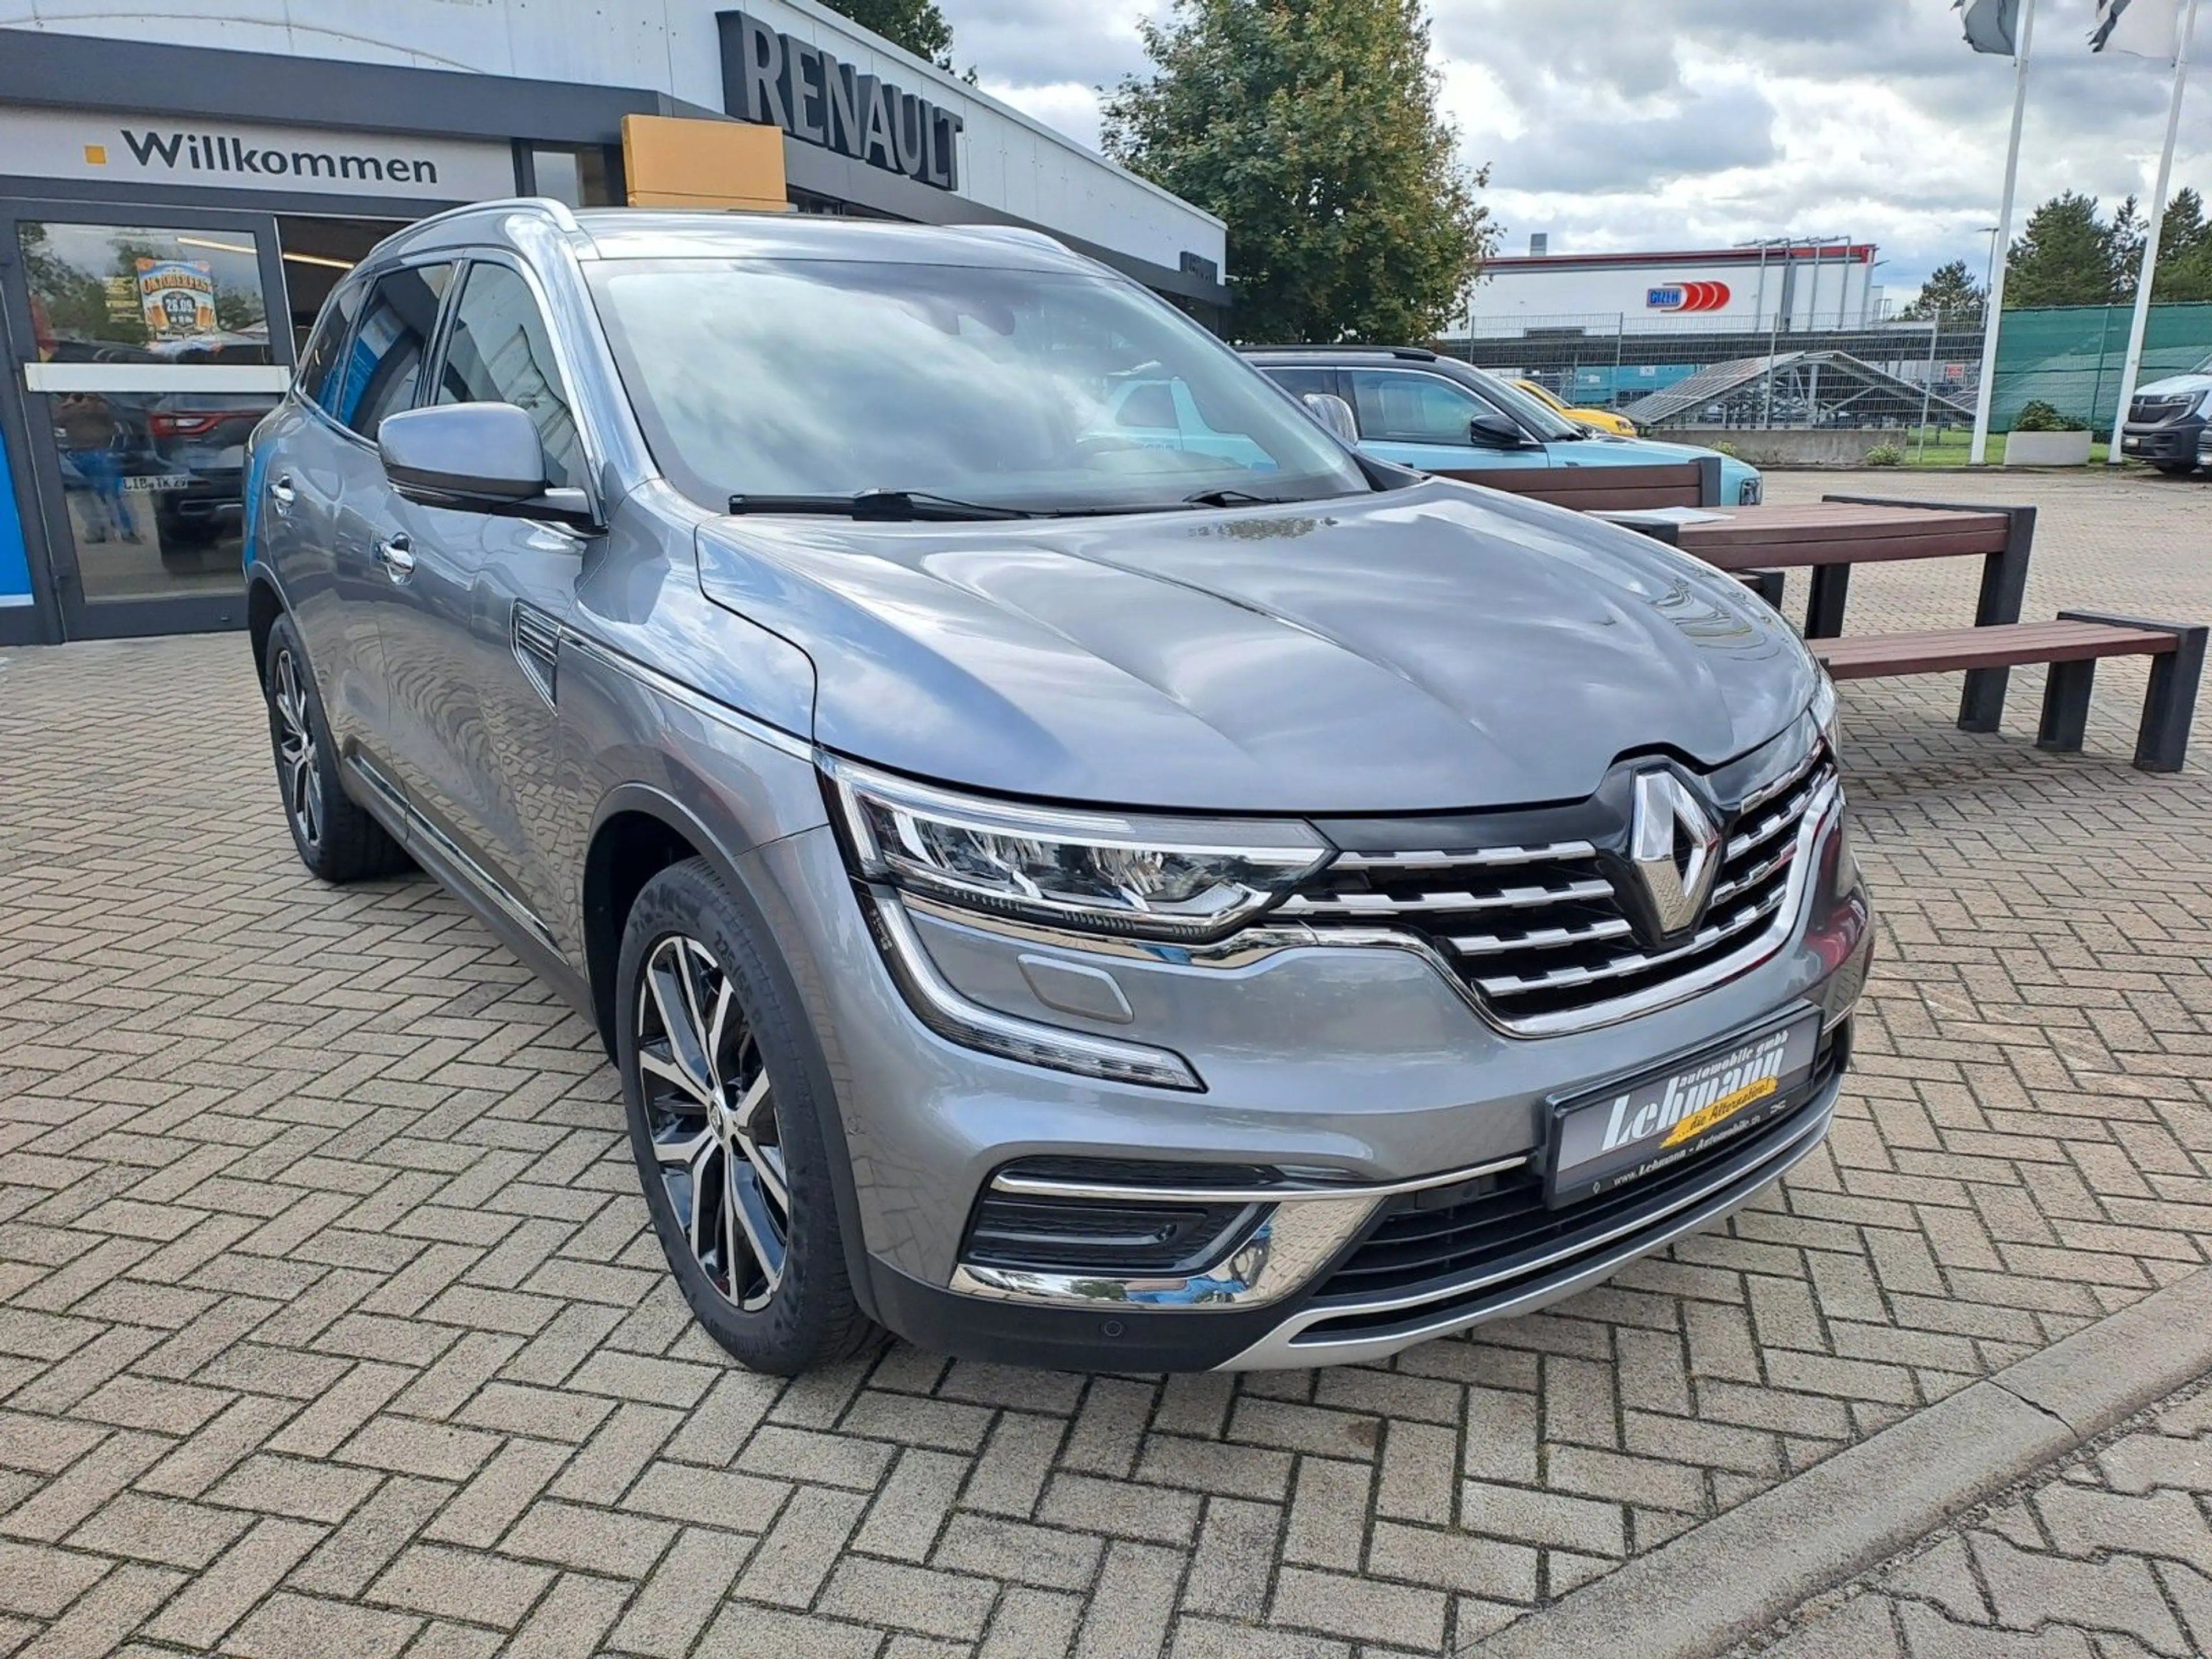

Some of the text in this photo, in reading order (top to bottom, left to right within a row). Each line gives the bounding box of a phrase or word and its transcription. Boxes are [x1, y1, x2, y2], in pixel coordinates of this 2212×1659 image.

[715, 10, 963, 191] RENAULT
[120, 129, 438, 183] Willkommen
[1601, 1047, 1785, 1151] Lehmann
[1679, 1030, 1789, 1088] automobile gmbh
